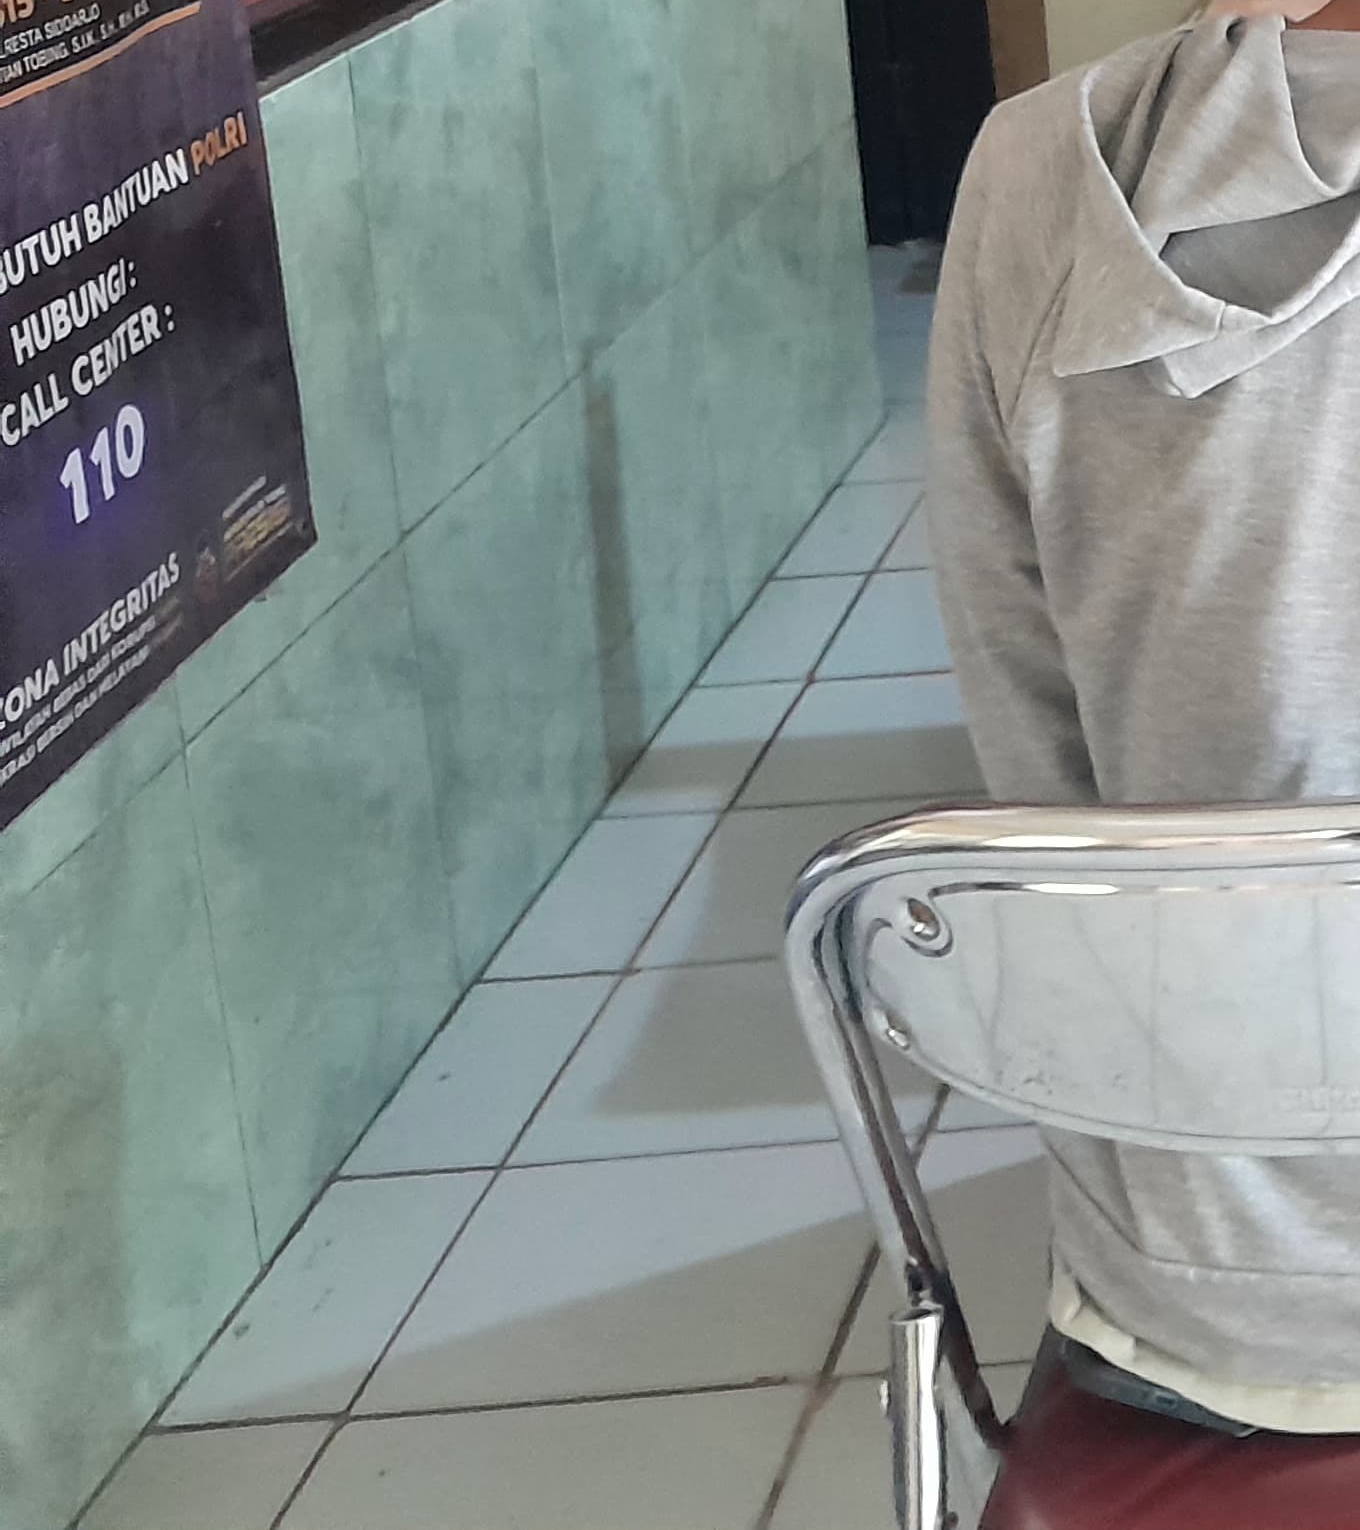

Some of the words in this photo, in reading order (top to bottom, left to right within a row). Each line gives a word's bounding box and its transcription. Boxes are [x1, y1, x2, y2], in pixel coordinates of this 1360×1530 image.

[82, 148, 189, 245] BANTUAN
[190, 112, 248, 175] POLRI
[1, 373, 68, 447] CALL
[72, 303, 161, 397] CENTER
[60, 404, 145, 525] 110
[0, 658, 59, 730] ONA
[63, 551, 180, 676] INTEGRITAS
